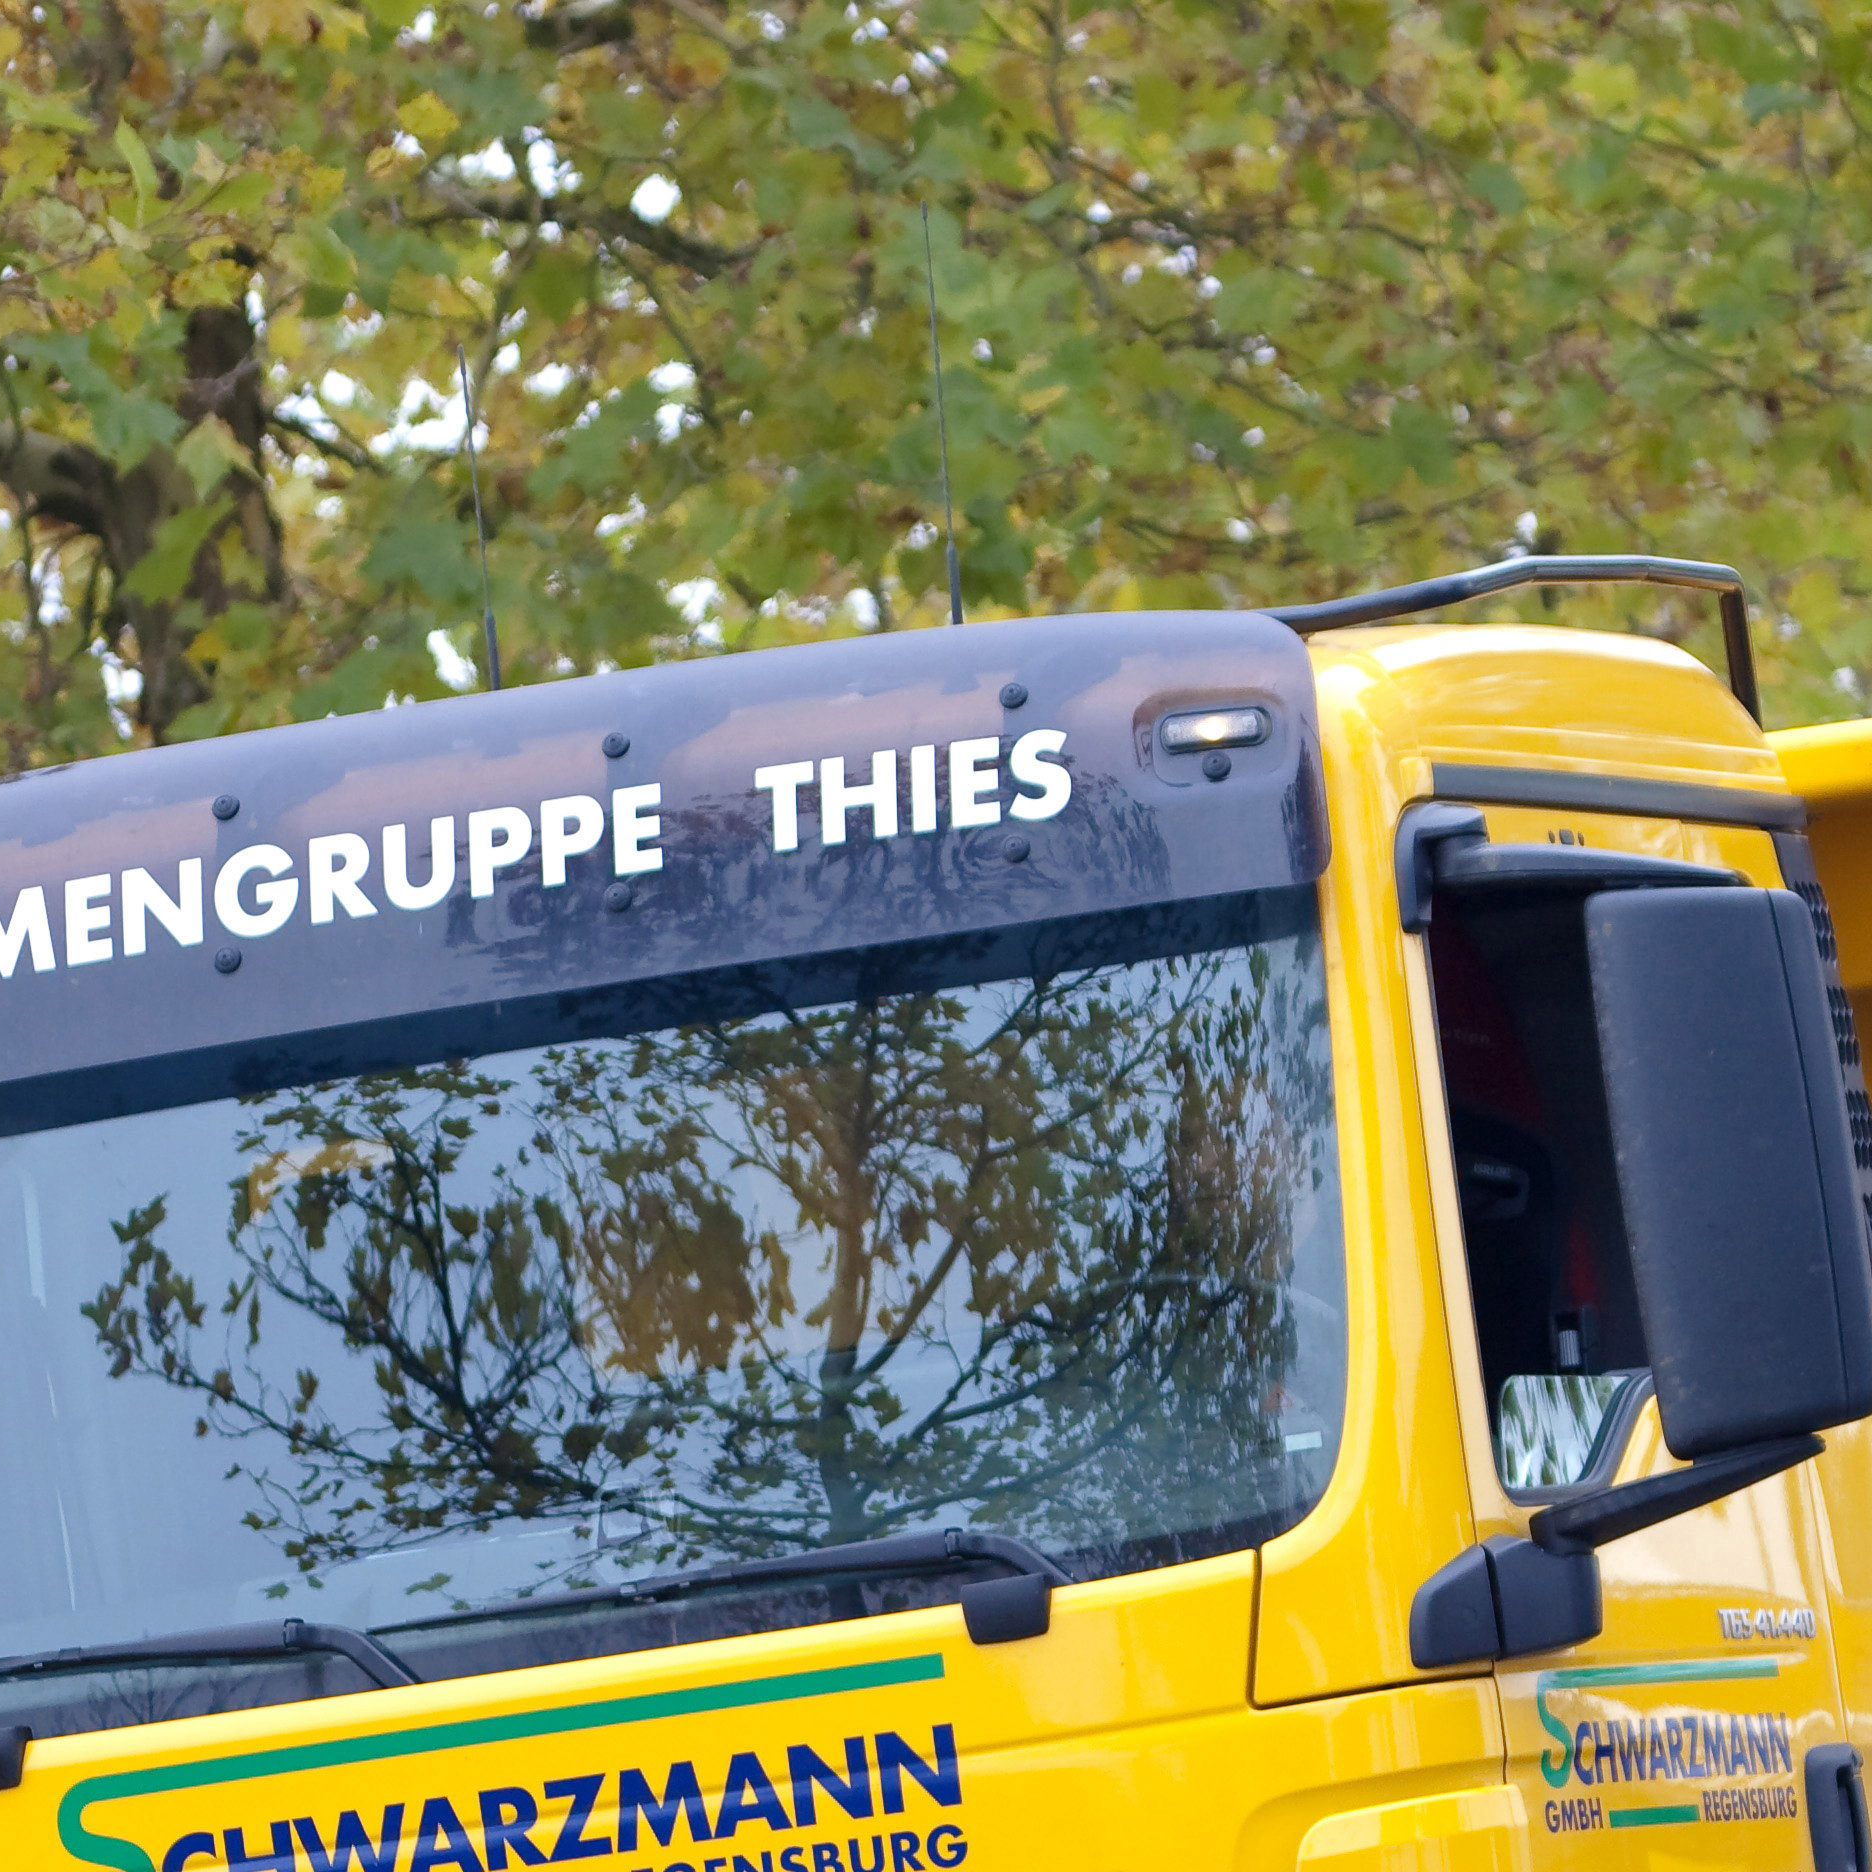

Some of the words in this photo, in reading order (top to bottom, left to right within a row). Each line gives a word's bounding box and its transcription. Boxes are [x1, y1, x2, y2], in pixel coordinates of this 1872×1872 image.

[752, 728, 1074, 855] THIES
[1536, 1672, 1793, 1788] SCHWARZMANN
[1545, 1797, 1604, 1833] GMBH
[1702, 1786, 1797, 1822] REGENSBURG
